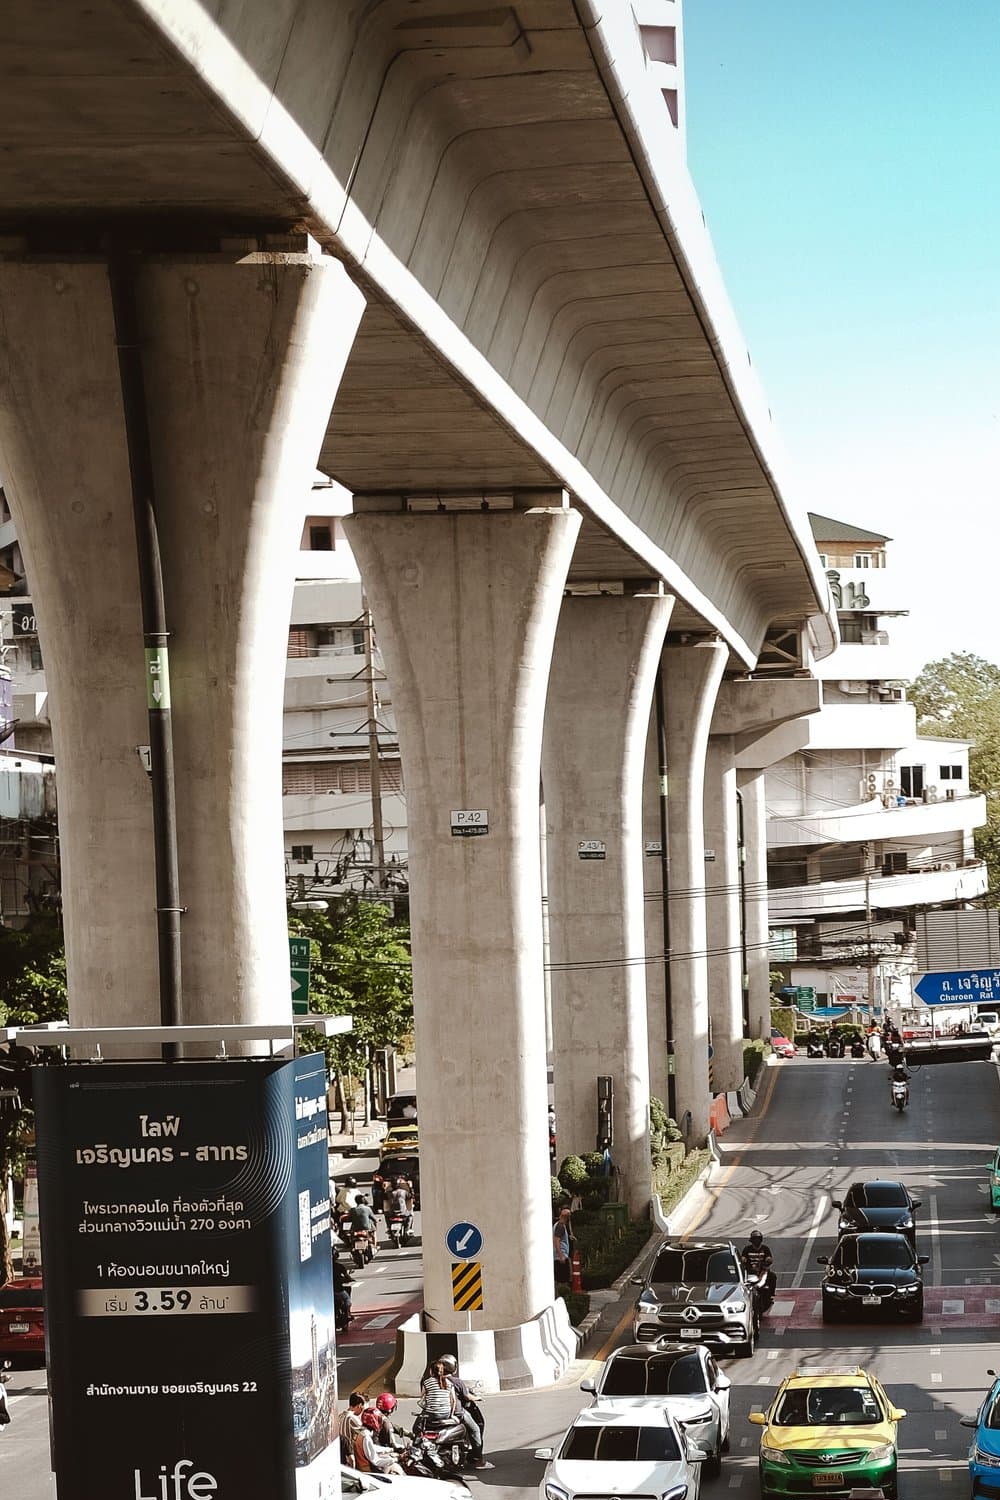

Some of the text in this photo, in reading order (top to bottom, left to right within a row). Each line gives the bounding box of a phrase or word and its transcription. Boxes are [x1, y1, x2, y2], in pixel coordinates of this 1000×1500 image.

[457, 812, 481, 823] P.42
[939, 993, 973, 1002] Charoen
[979, 991, 994, 999] Rat
[139, 1114, 180, 1138] ไลฟ์
[76, 1144, 174, 1168] เจริญนคร
[195, 1144, 248, 1162] สาทร
[83, 1196, 244, 1215] ไพรเวทคอนโด ที่ลงตัวที่สุด
[78, 1215, 251, 1233] ส่วนกลางวิวแม่น้ำ 270 องศา
[97, 1260, 230, 1278] 1 ห้องนอนขนาดใหญ่
[105, 1296, 128, 1312] เริ่ม
[134, 1290, 192, 1312] 3.59
[86, 1383, 159, 1396] สำนักงานขาย
[242, 1381, 258, 1392] 22
